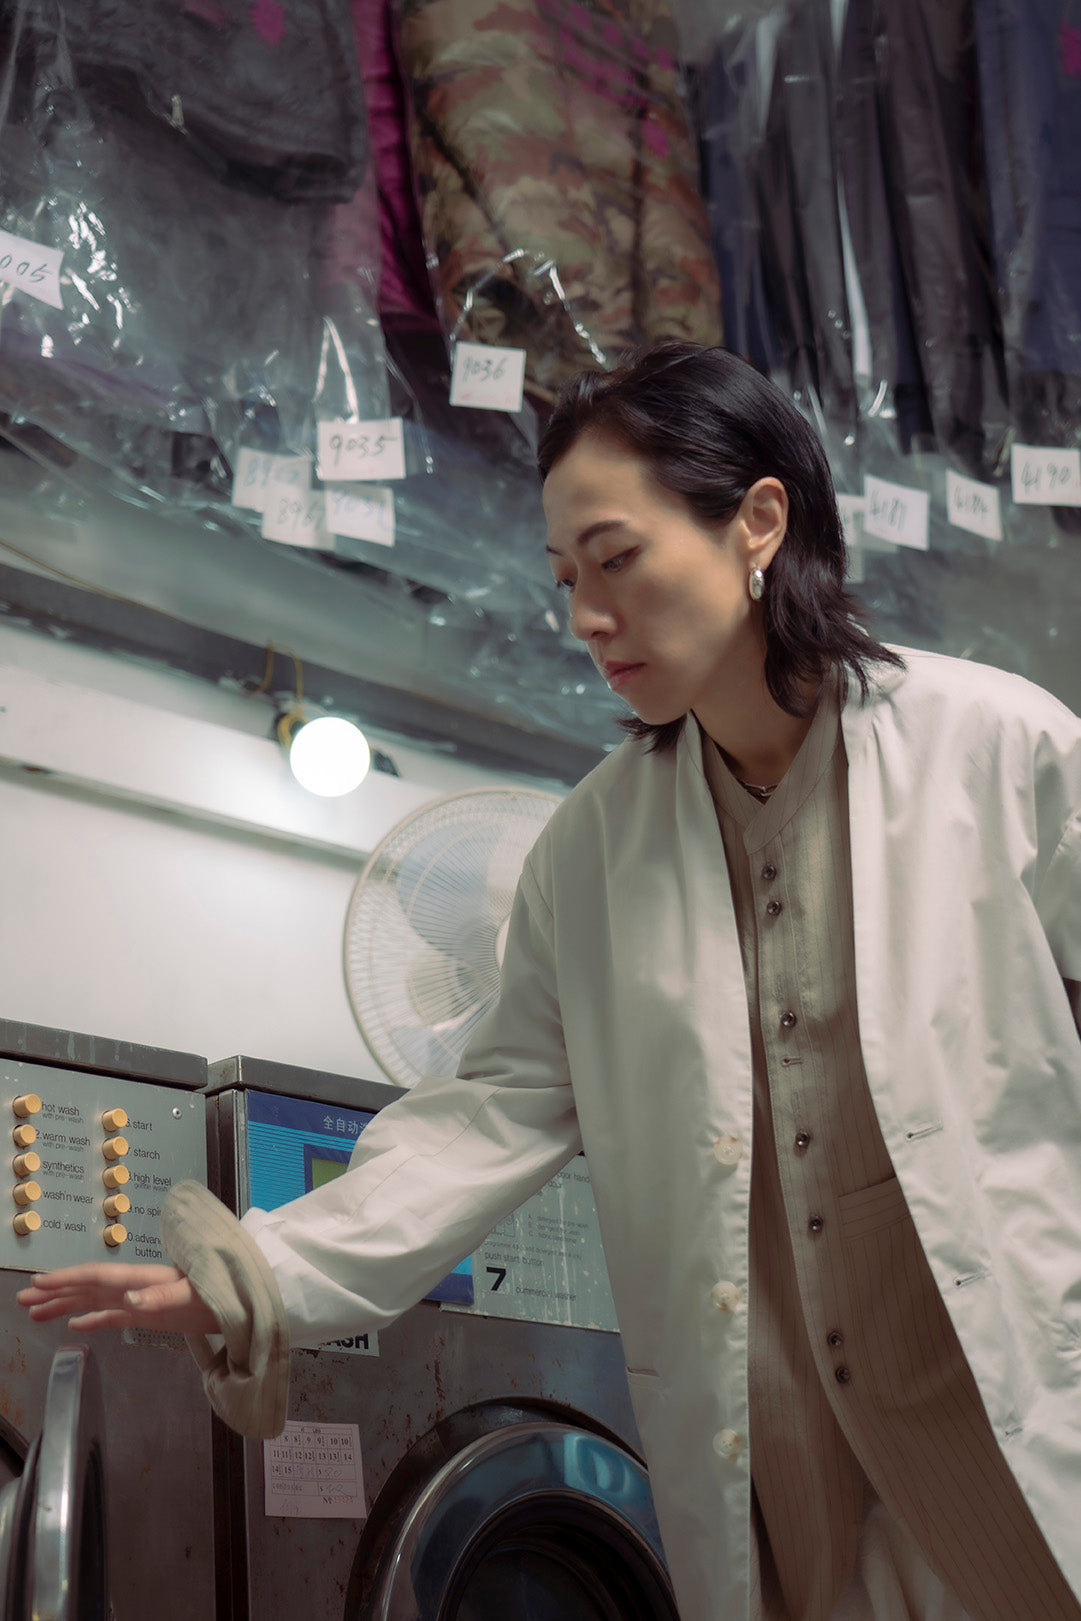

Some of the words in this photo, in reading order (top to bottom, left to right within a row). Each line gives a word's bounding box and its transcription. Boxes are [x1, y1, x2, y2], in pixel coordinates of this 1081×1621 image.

[462, 355, 508, 383] 9036
[329, 434, 398, 466] 9035
[41, 1102, 55, 1112] hot
[58, 1106, 79, 1116] wash
[69, 1137, 90, 1146] wash
[134, 1149, 160, 1160] starch
[43, 1161, 85, 1174] synthetics
[153, 1175, 171, 1187] level
[72, 1195, 94, 1205] wear
[64, 1222, 87, 1232] wash
[136, 1246, 162, 1258] button
[485, 1253, 502, 1261] push
[503, 1255, 519, 1263] start
[522, 1257, 544, 1266] button
[486, 1267, 507, 1291] 7
